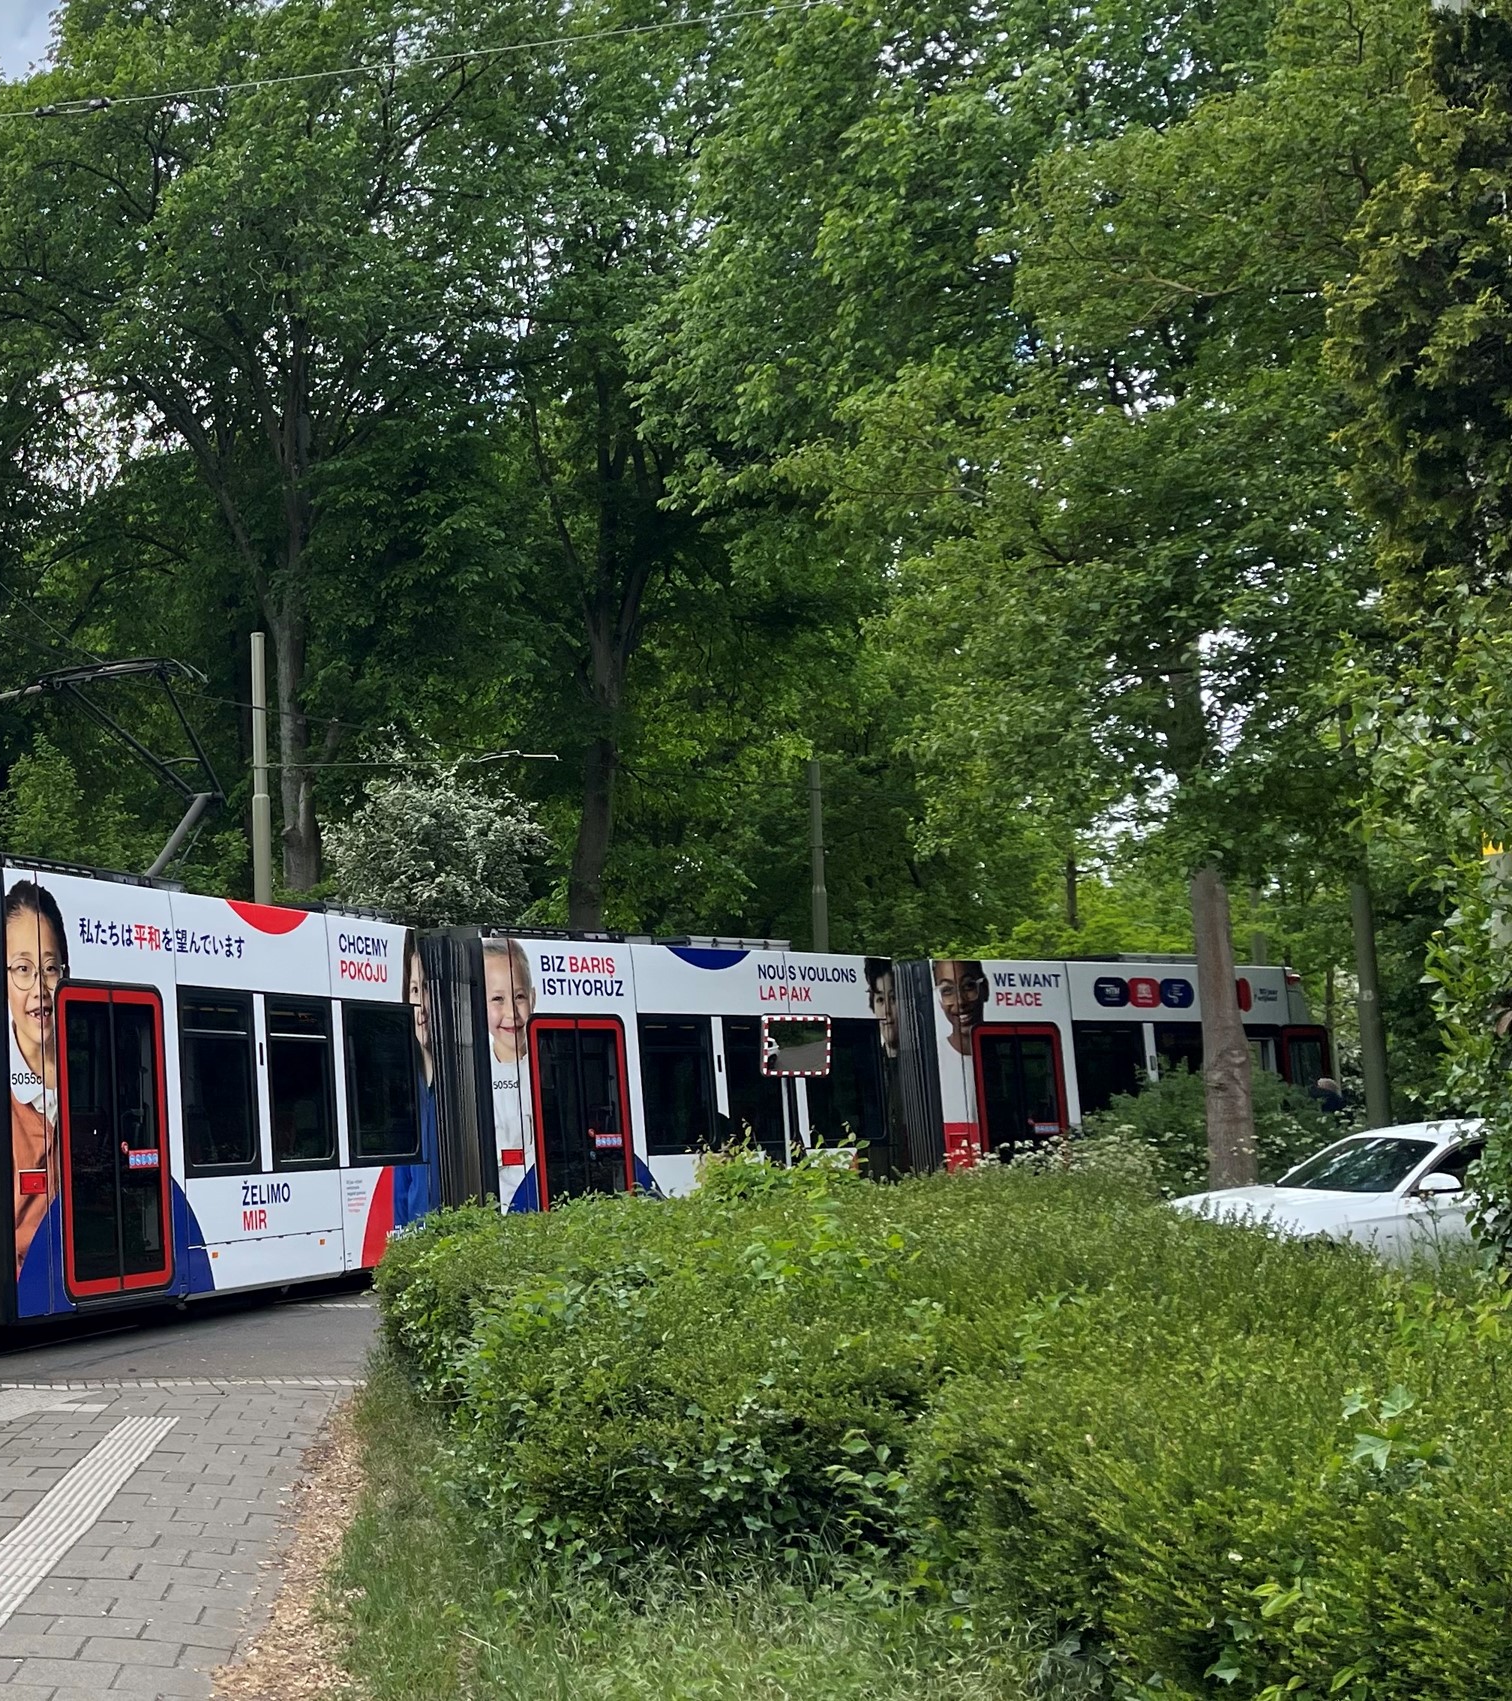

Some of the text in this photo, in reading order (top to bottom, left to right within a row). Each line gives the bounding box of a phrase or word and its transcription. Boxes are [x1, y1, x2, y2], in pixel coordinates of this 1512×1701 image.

[79, 917, 246, 959] 私たちは平和を望んでいます
[338, 933, 388, 958] CHCEMY
[340, 958, 388, 983] POKÓJU
[540, 955, 615, 979] BIZ BARIŞ
[757, 964, 857, 984] NOUS VOULONS
[542, 978, 624, 997] ISTIYORUZ
[993, 973, 1061, 988] WE WANT
[759, 985, 812, 1002] LA PAIX
[995, 991, 1043, 1006] PEACE
[12, 1071, 43, 1085] 5055c
[242, 1180, 291, 1206] ŽELIMO
[243, 1209, 267, 1231] MIR
